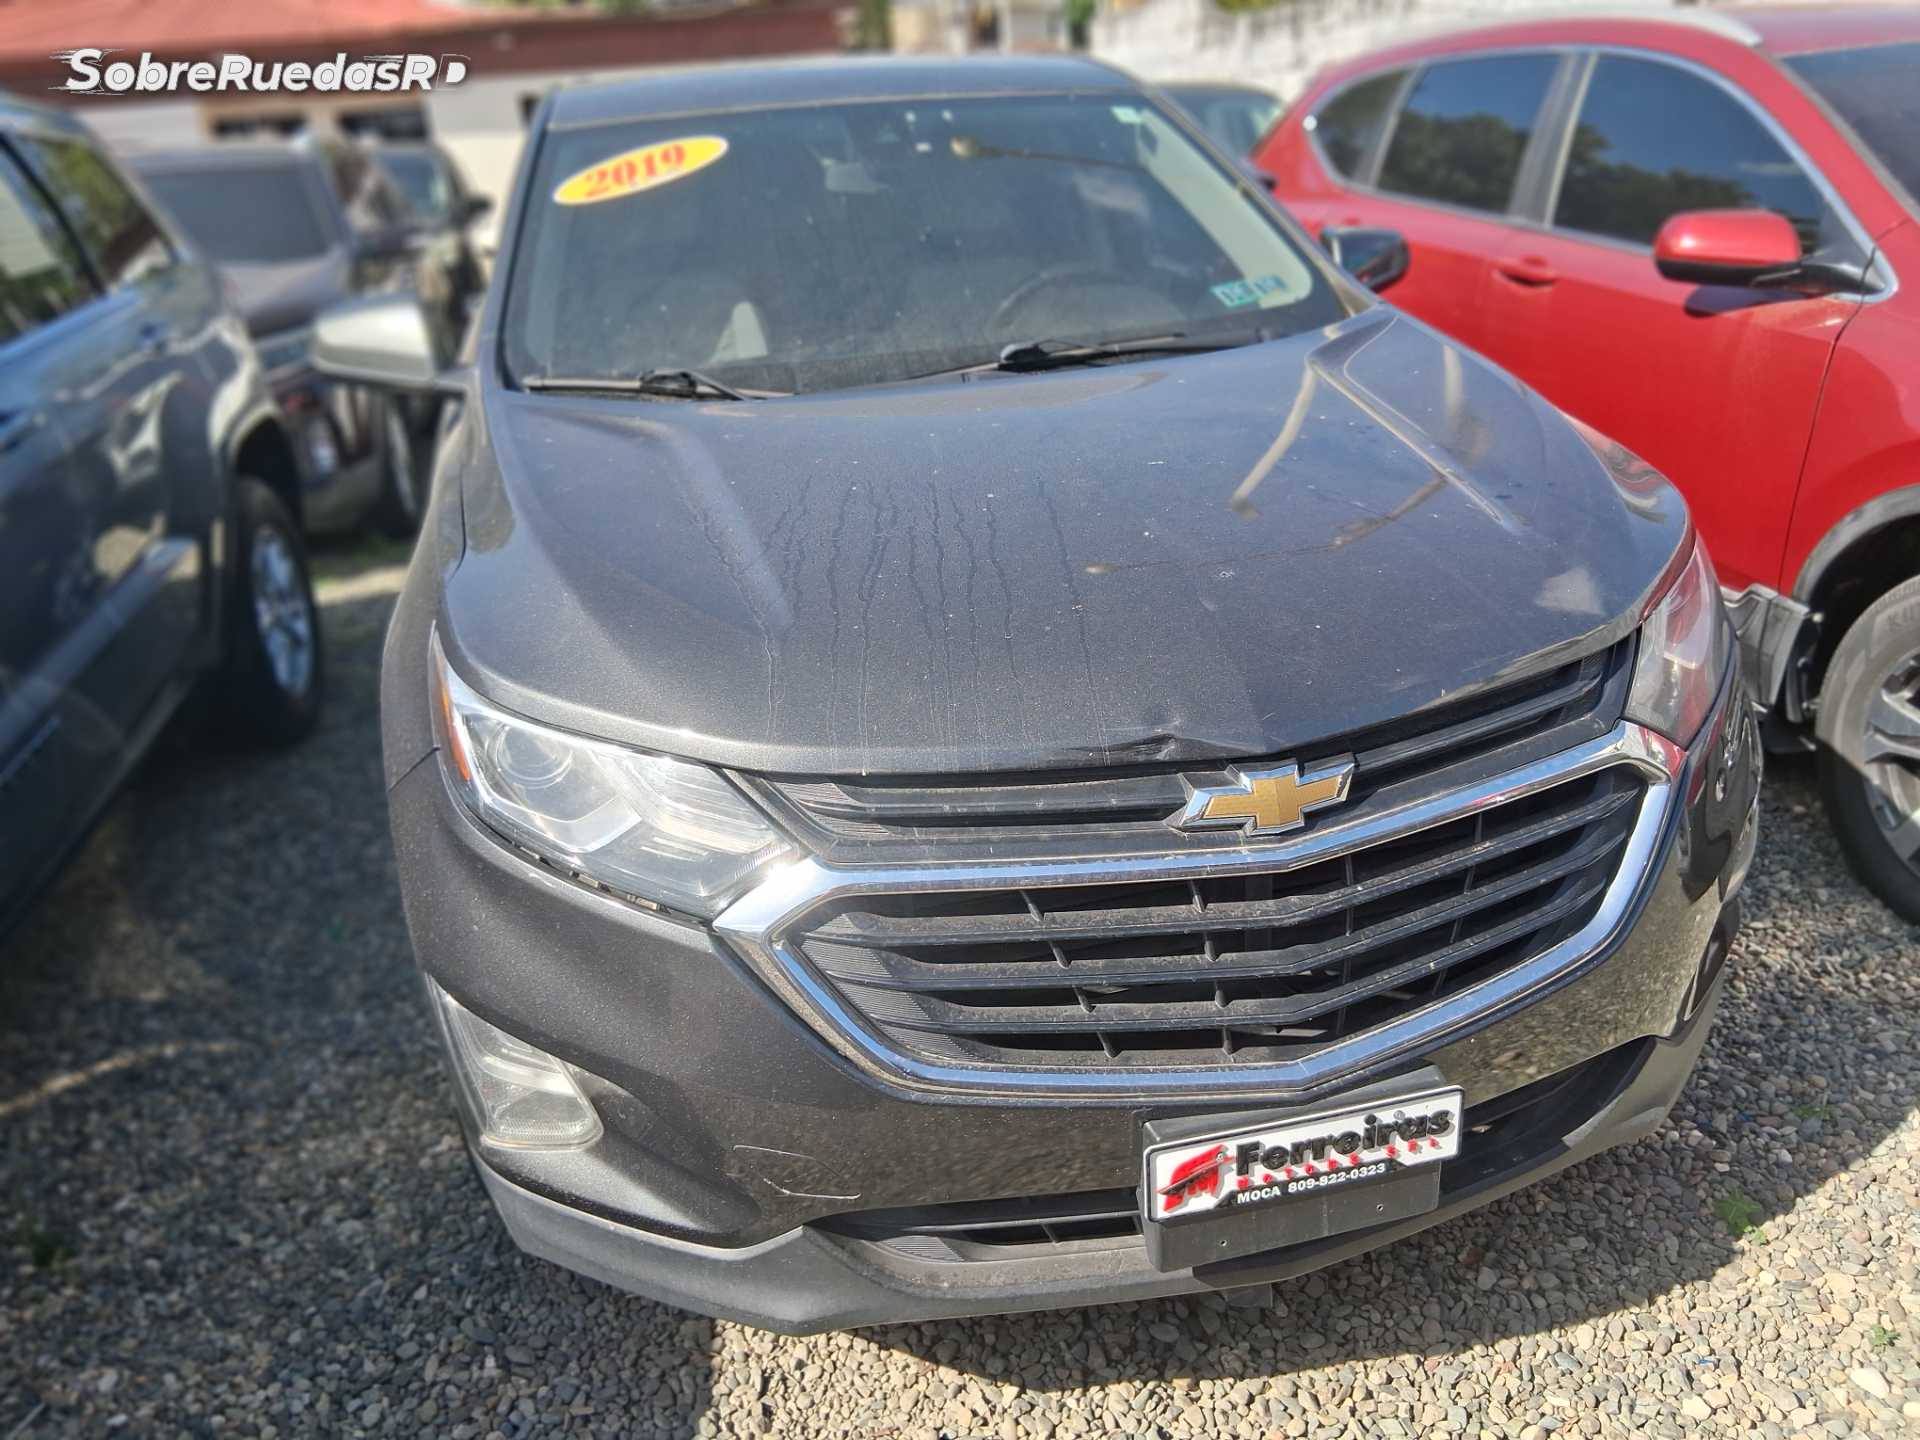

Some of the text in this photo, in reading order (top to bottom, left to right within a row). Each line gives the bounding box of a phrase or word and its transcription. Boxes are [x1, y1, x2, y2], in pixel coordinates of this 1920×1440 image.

[584, 144, 687, 198] 2019
[1237, 1163, 1386, 1204] MOCA 809-822-0323
